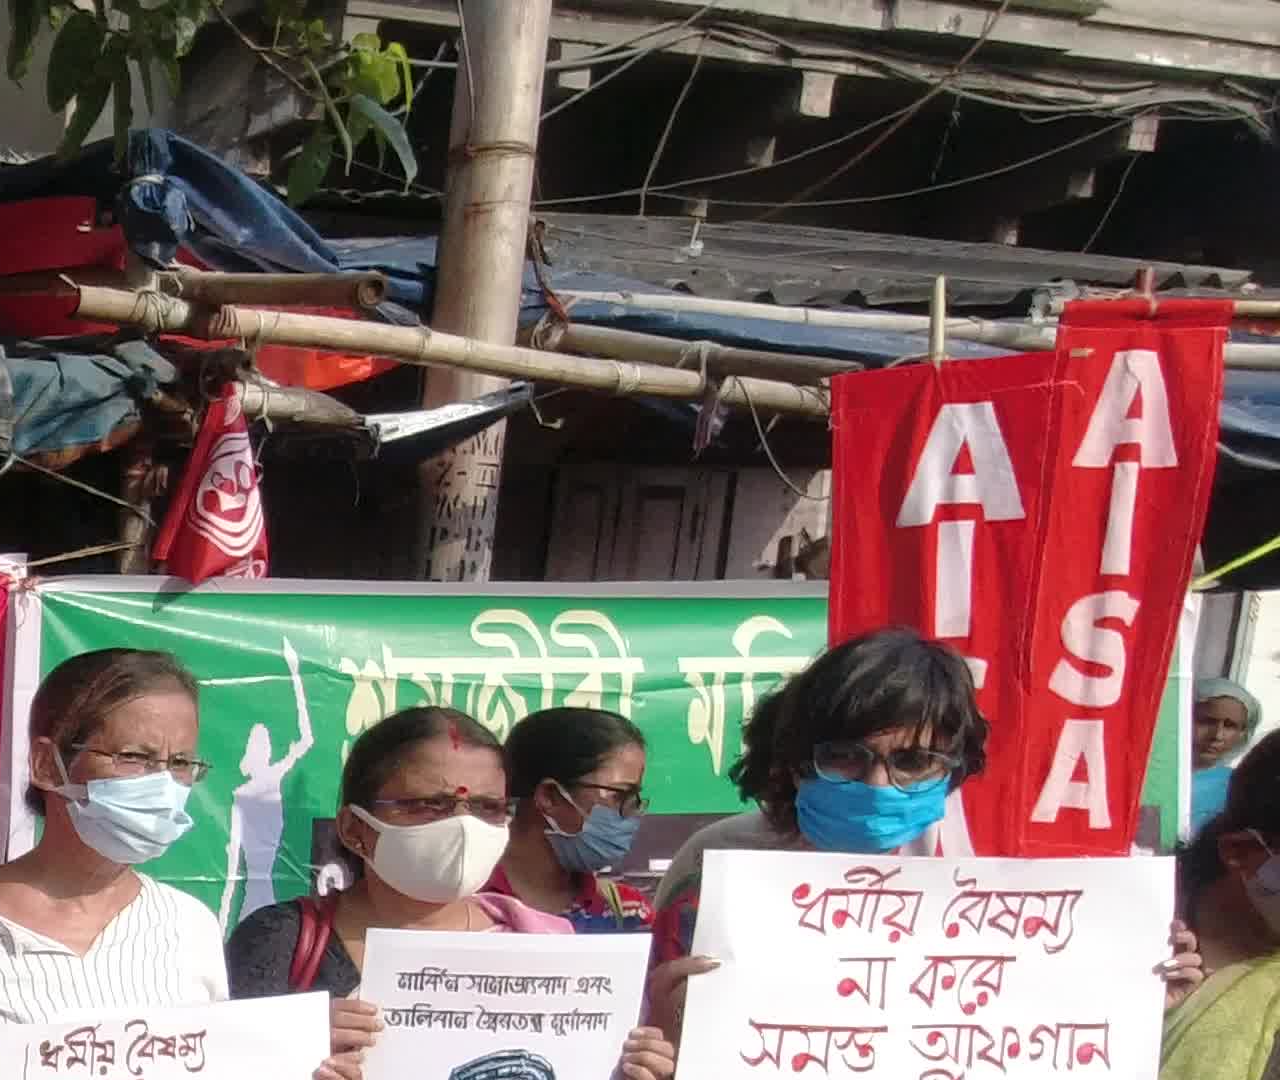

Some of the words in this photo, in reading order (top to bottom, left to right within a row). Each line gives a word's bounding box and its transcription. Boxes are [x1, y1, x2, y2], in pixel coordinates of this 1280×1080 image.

[1030, 348, 1179, 830] AISA
[791, 867, 923, 943] ধর্মীয়
[940, 868, 1084, 955] বৈষম্য
[574, 976, 614, 995] এবং
[836, 956, 896, 1010] না
[908, 954, 1016, 1015] করে
[382, 1003, 472, 1030] তালিবান
[739, 1018, 889, 1072] সমস্ত
[909, 1021, 1112, 1072] আফগান
